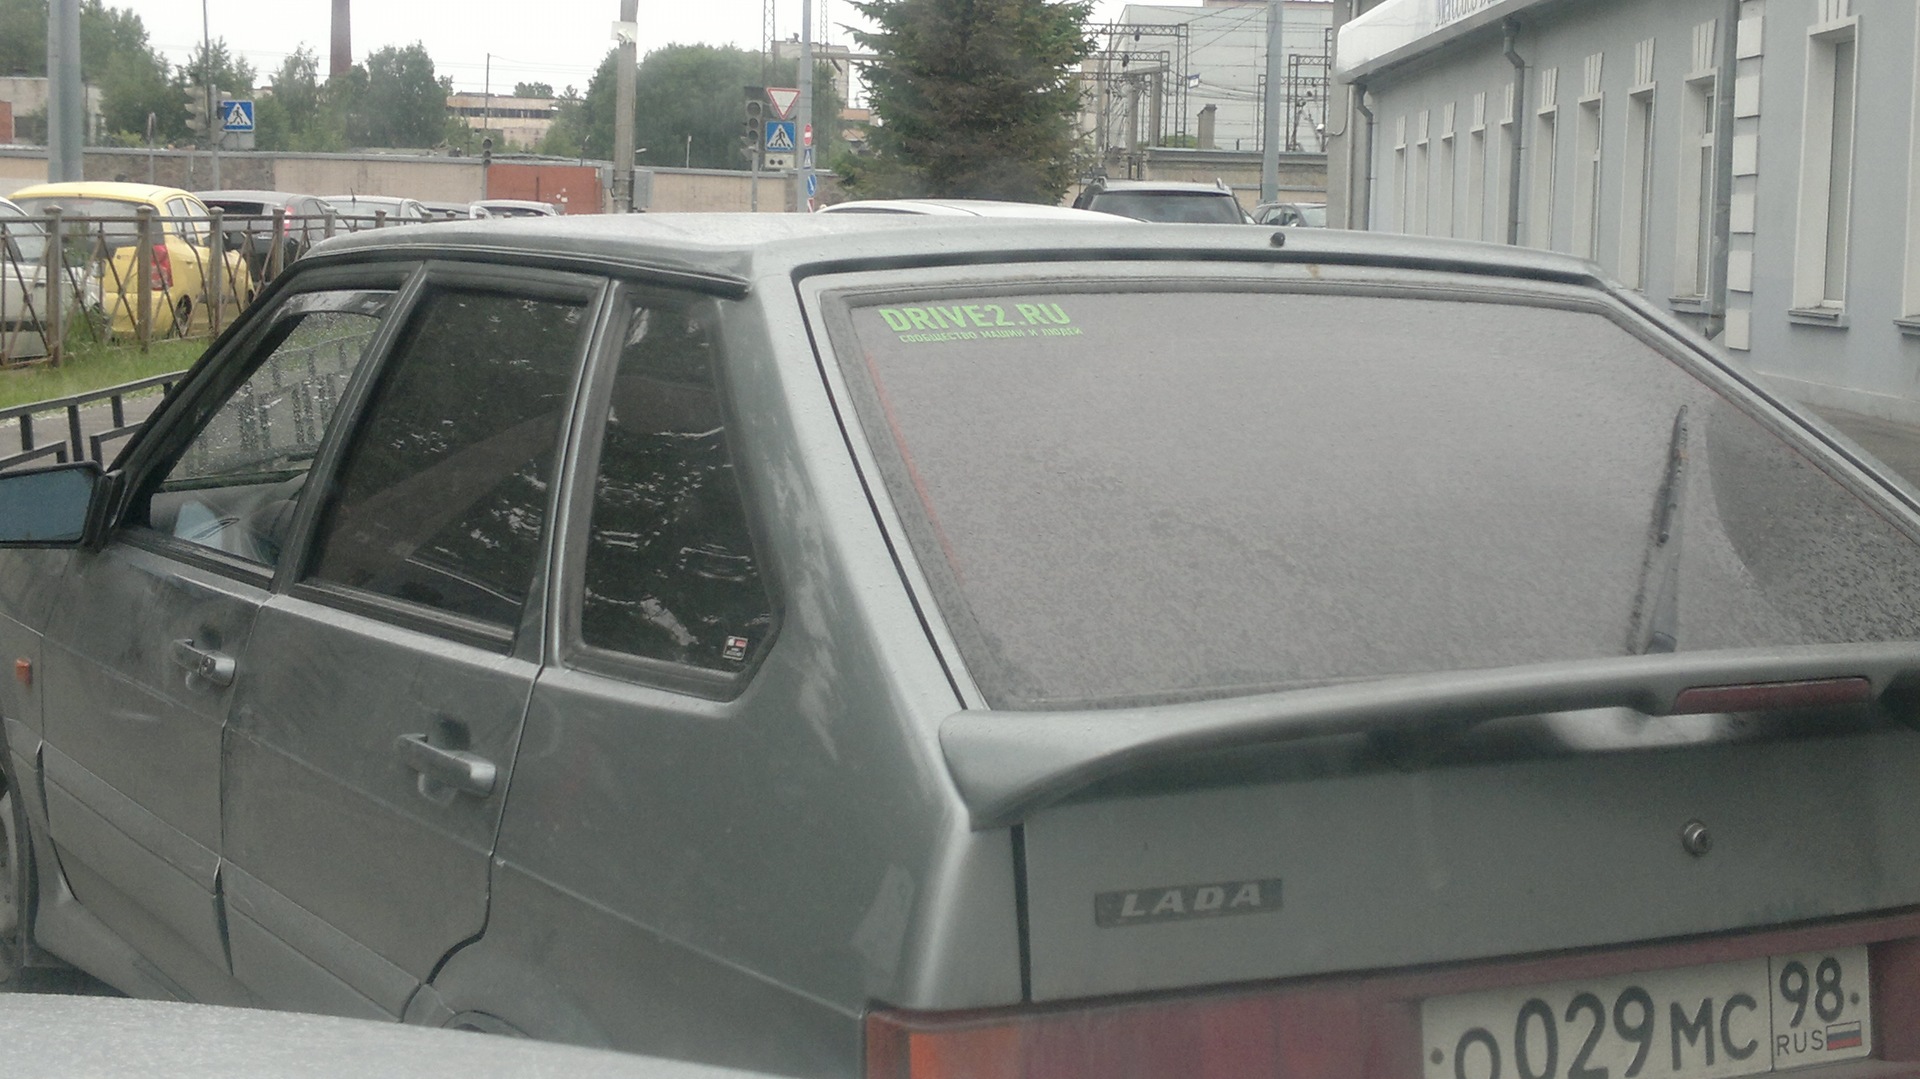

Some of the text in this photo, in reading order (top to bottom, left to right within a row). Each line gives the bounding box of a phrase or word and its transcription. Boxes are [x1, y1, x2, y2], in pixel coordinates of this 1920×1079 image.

[879, 303, 1071, 332] DRIVE2.RU
[899, 331, 977, 343] СООБЩЕСТВО
[1121, 883, 1261, 917] LADA
[1779, 957, 1844, 1028] 98
[1776, 1029, 1824, 1056] RUS
